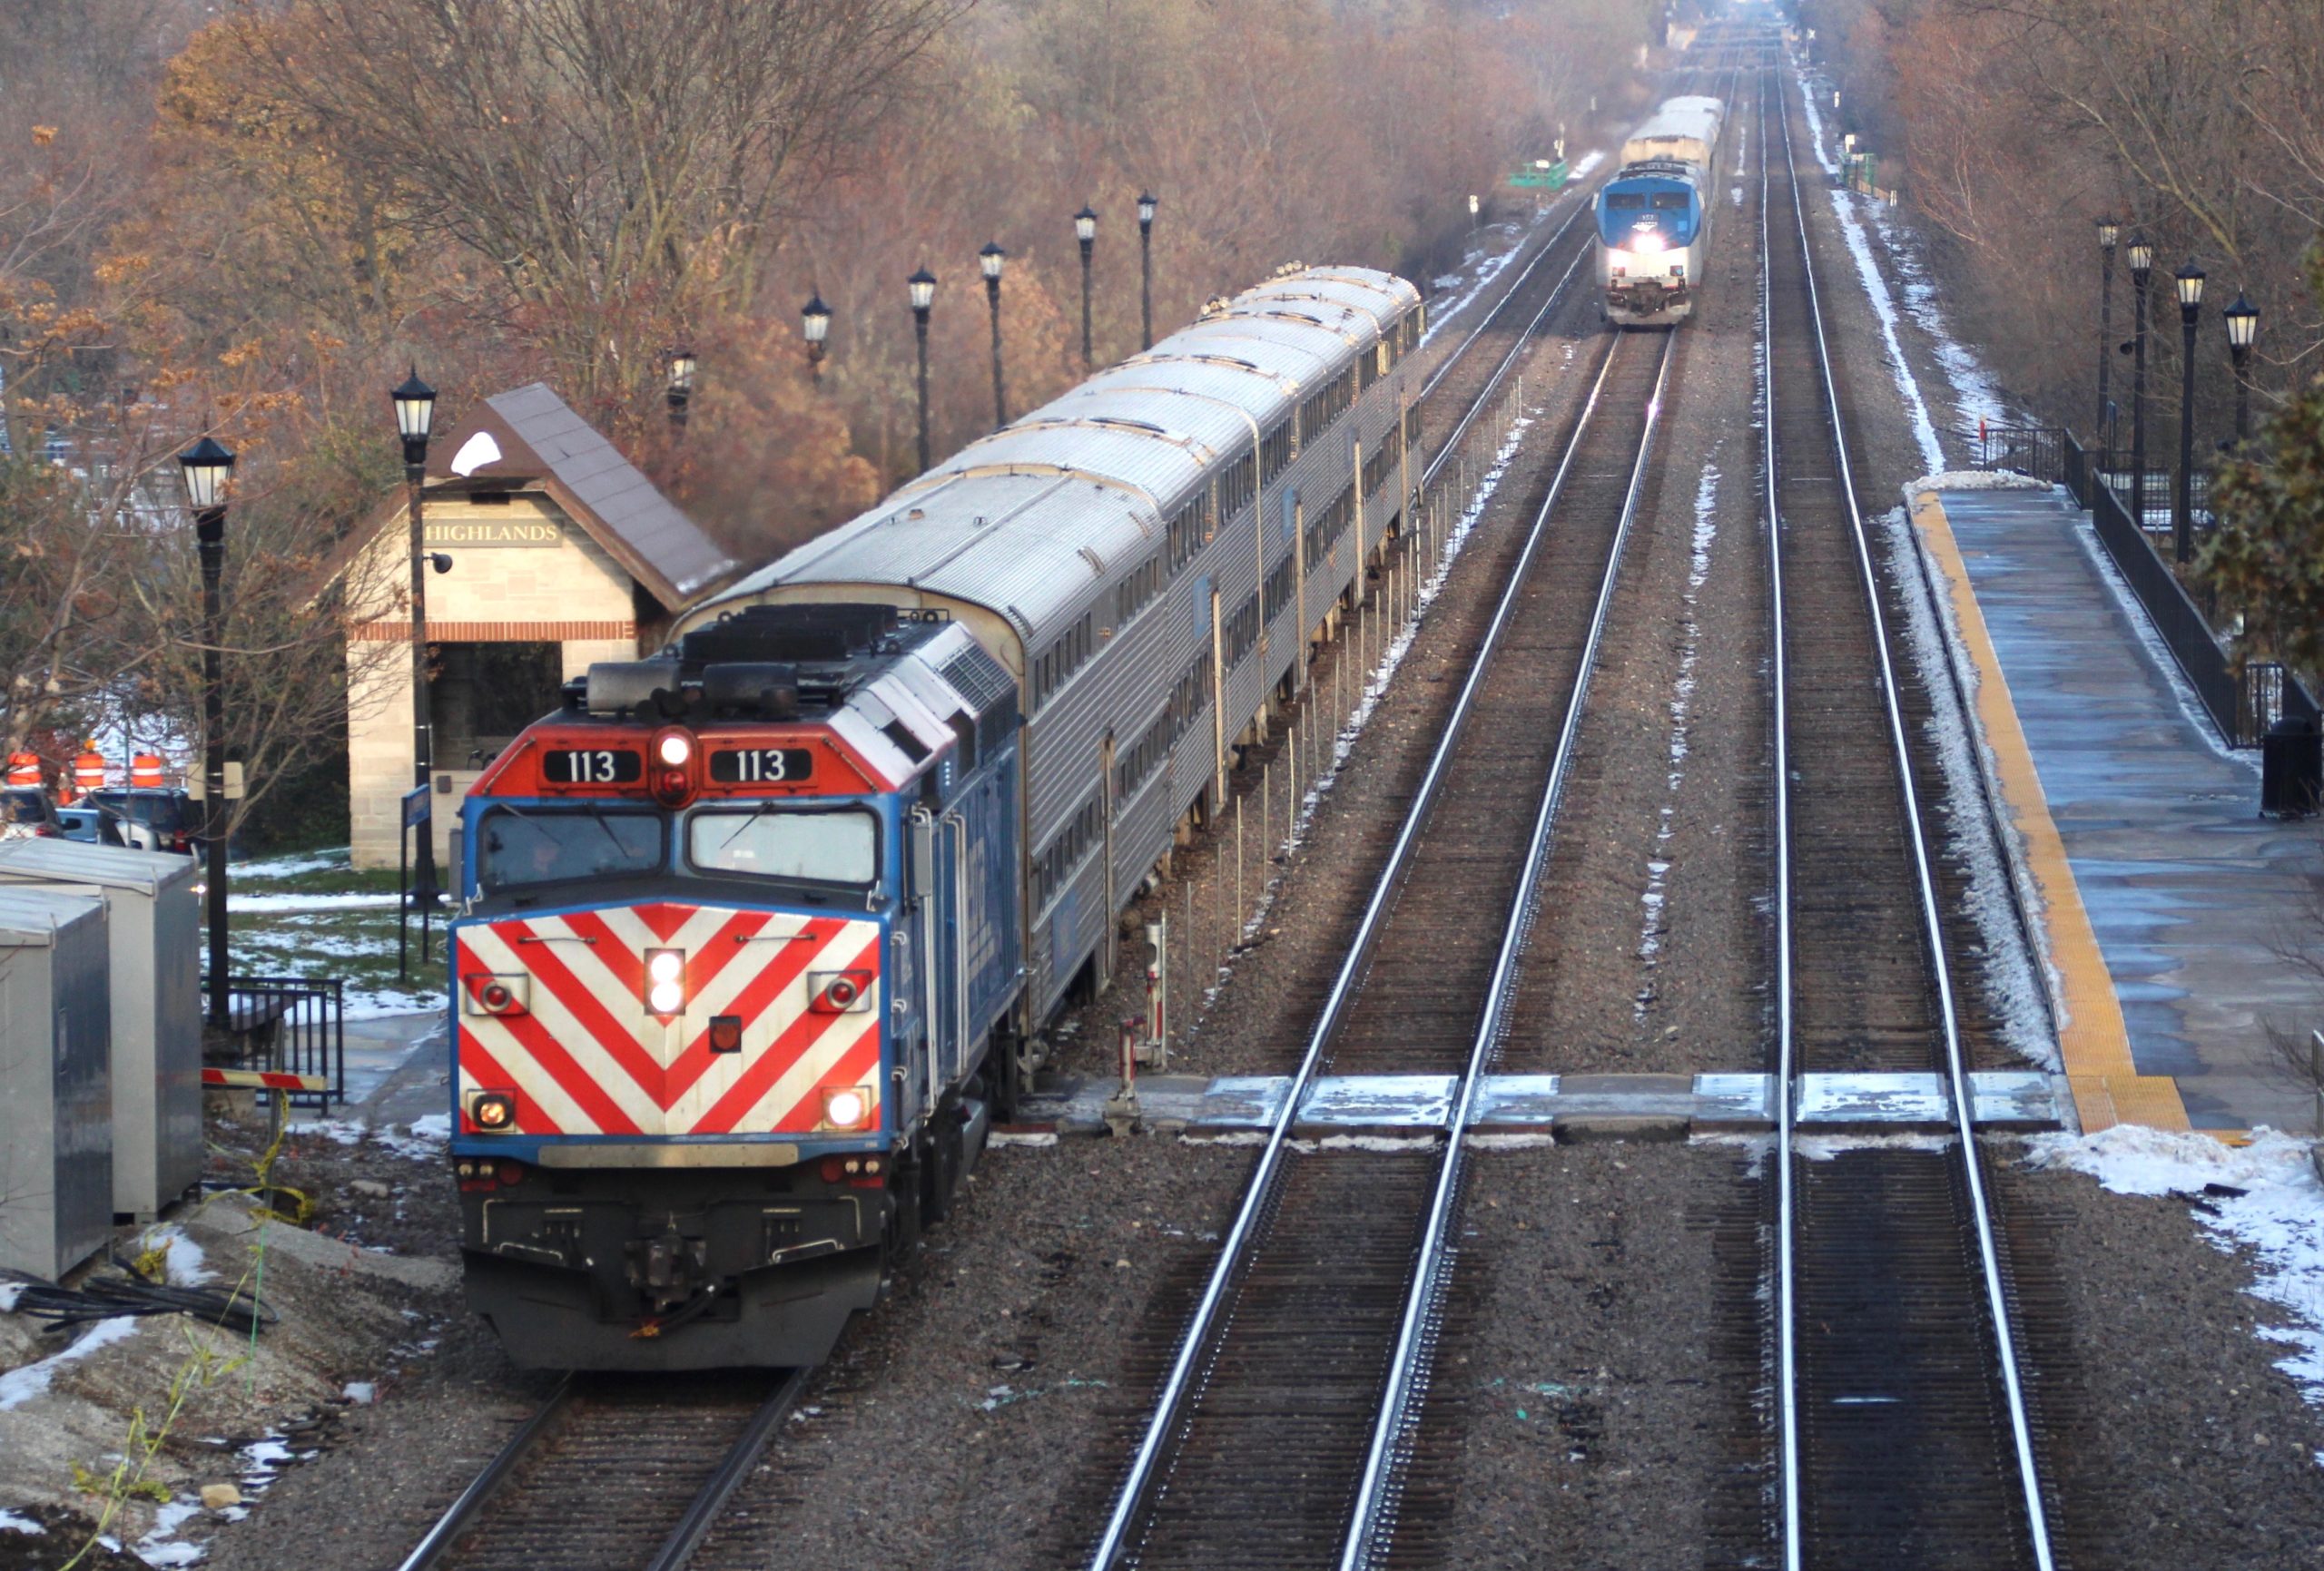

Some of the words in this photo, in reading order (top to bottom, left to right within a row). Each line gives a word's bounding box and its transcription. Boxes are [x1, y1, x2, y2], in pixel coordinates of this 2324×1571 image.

[425, 525, 557, 541] HIGHLANDS
[568, 751, 615, 782] 113
[737, 750, 785, 781] 113
